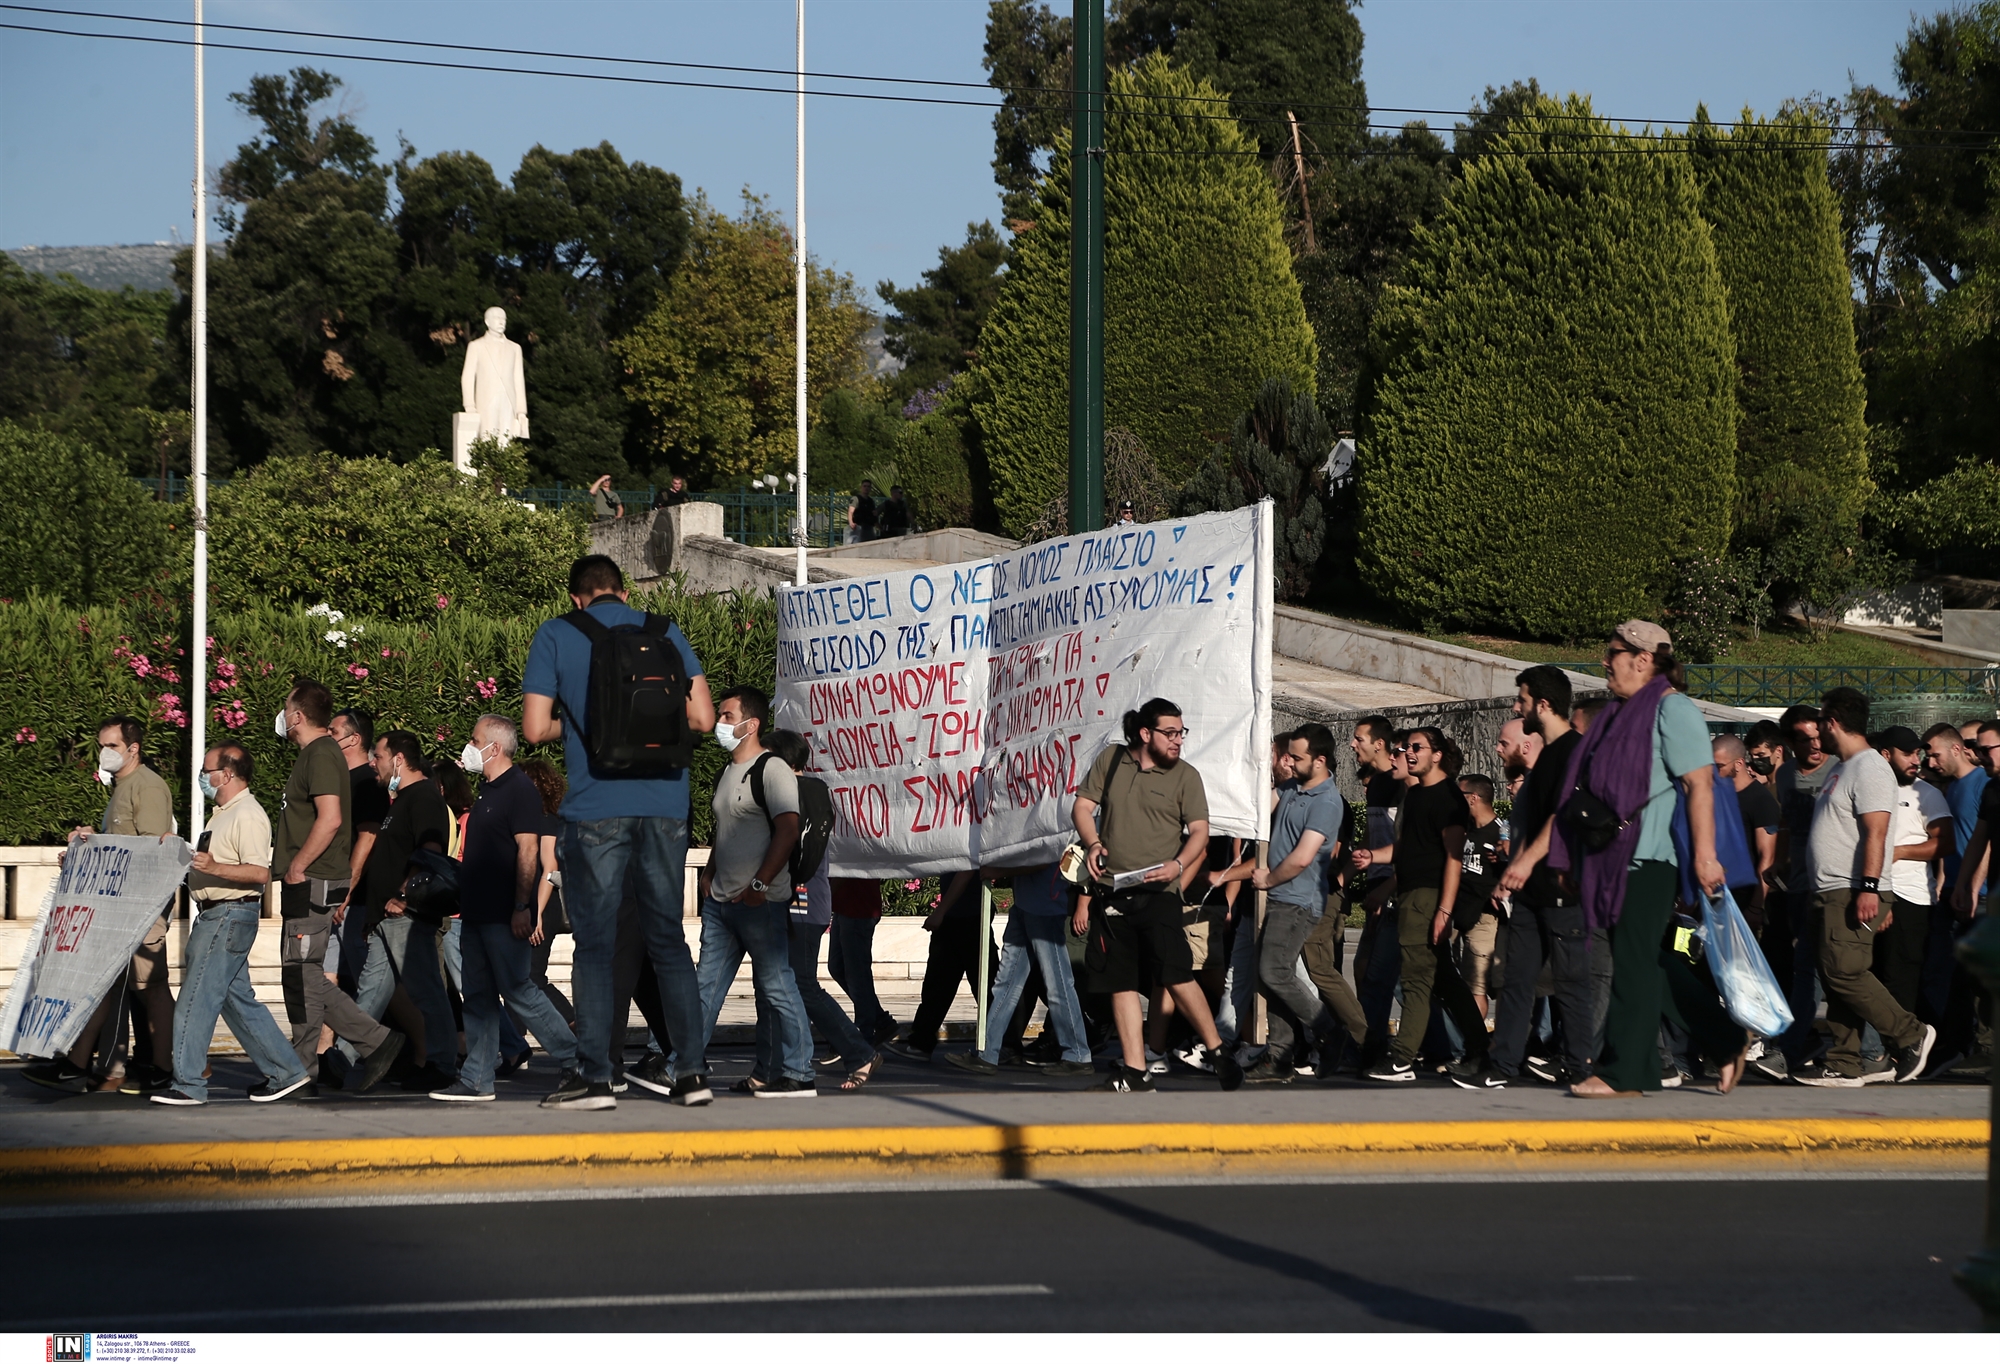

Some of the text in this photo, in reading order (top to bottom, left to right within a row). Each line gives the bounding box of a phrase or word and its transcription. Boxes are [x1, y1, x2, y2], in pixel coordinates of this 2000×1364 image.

[910, 573, 934, 613] Ο
[951, 559, 1010, 606] ΝΕΟΣ
[1017, 542, 1070, 592] ΝΟΜΟΣ
[1073, 529, 1156, 577] ΠΛΑΙΣΙΟ
[810, 630, 887, 675] ΕΙΣΟΔΟ
[898, 622, 931, 661] ΤΗΣ
[922, 709, 982, 759] ΖΩΗ
